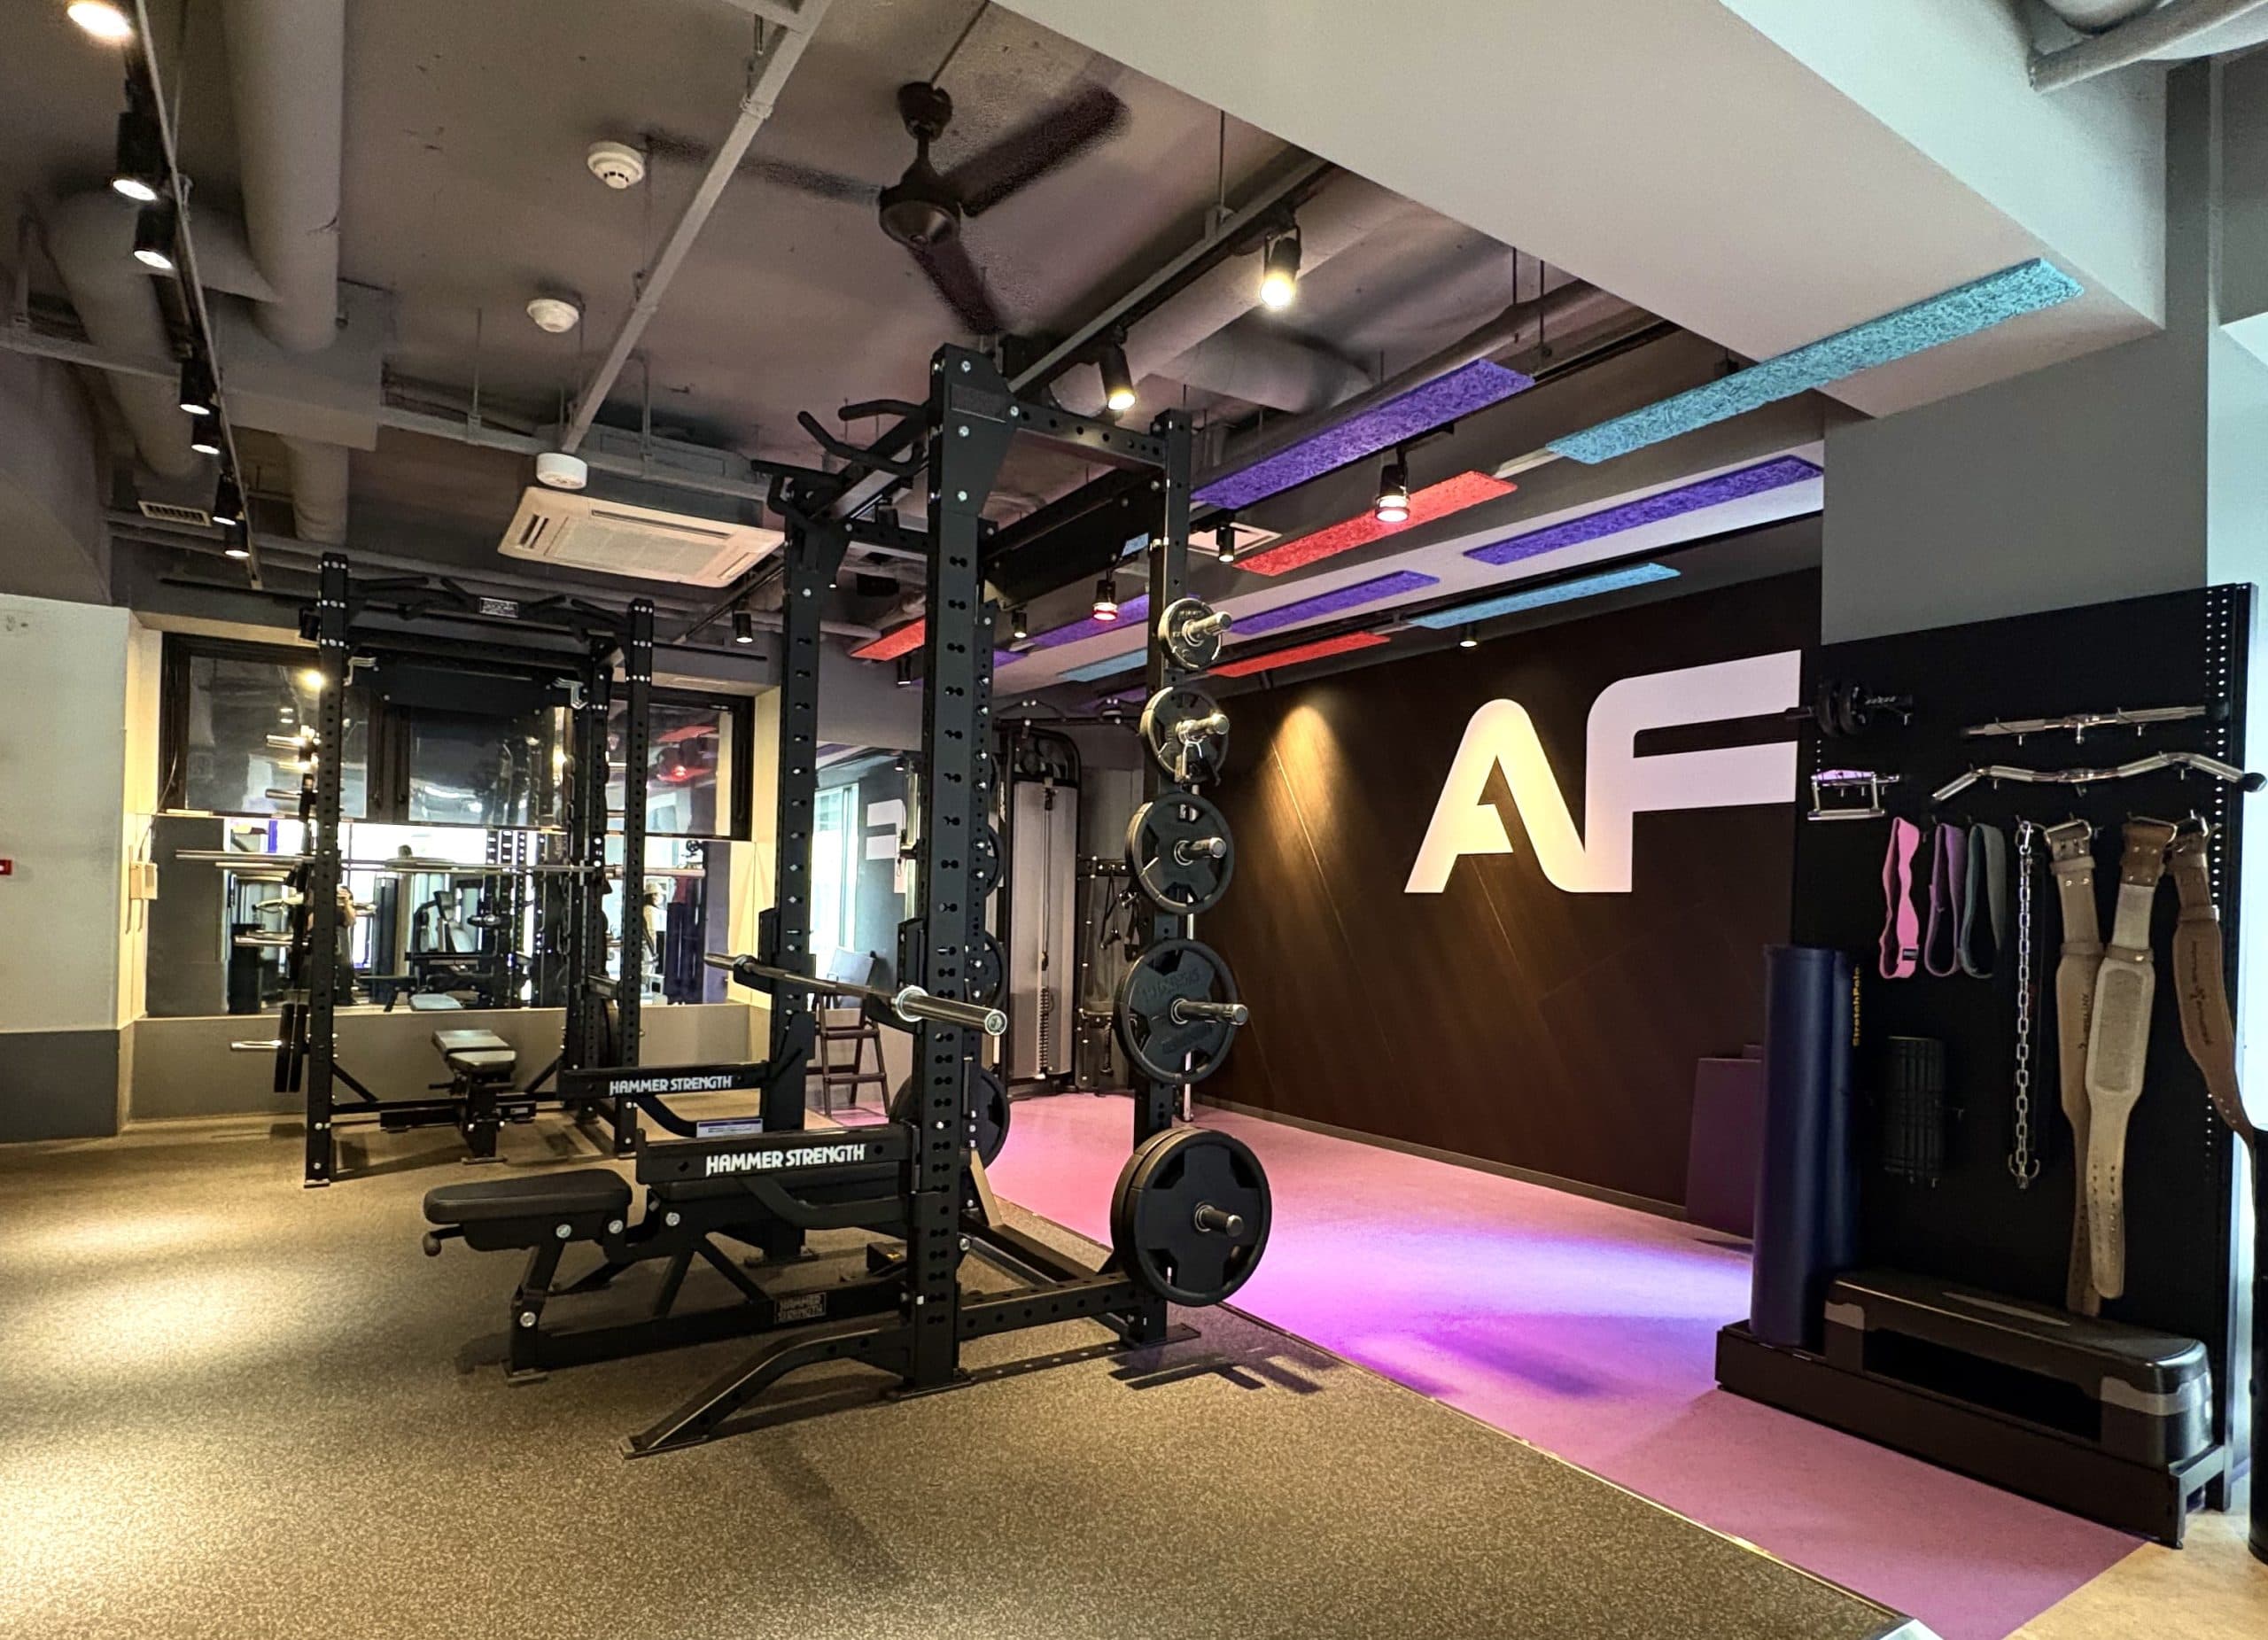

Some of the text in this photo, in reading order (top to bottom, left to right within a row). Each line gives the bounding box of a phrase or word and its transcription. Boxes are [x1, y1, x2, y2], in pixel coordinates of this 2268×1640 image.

[1404, 649, 1801, 893] AF
[610, 1075, 733, 1096] HAMMER STRENGTH
[705, 1143, 866, 1177] HAMMER STRENGTH
